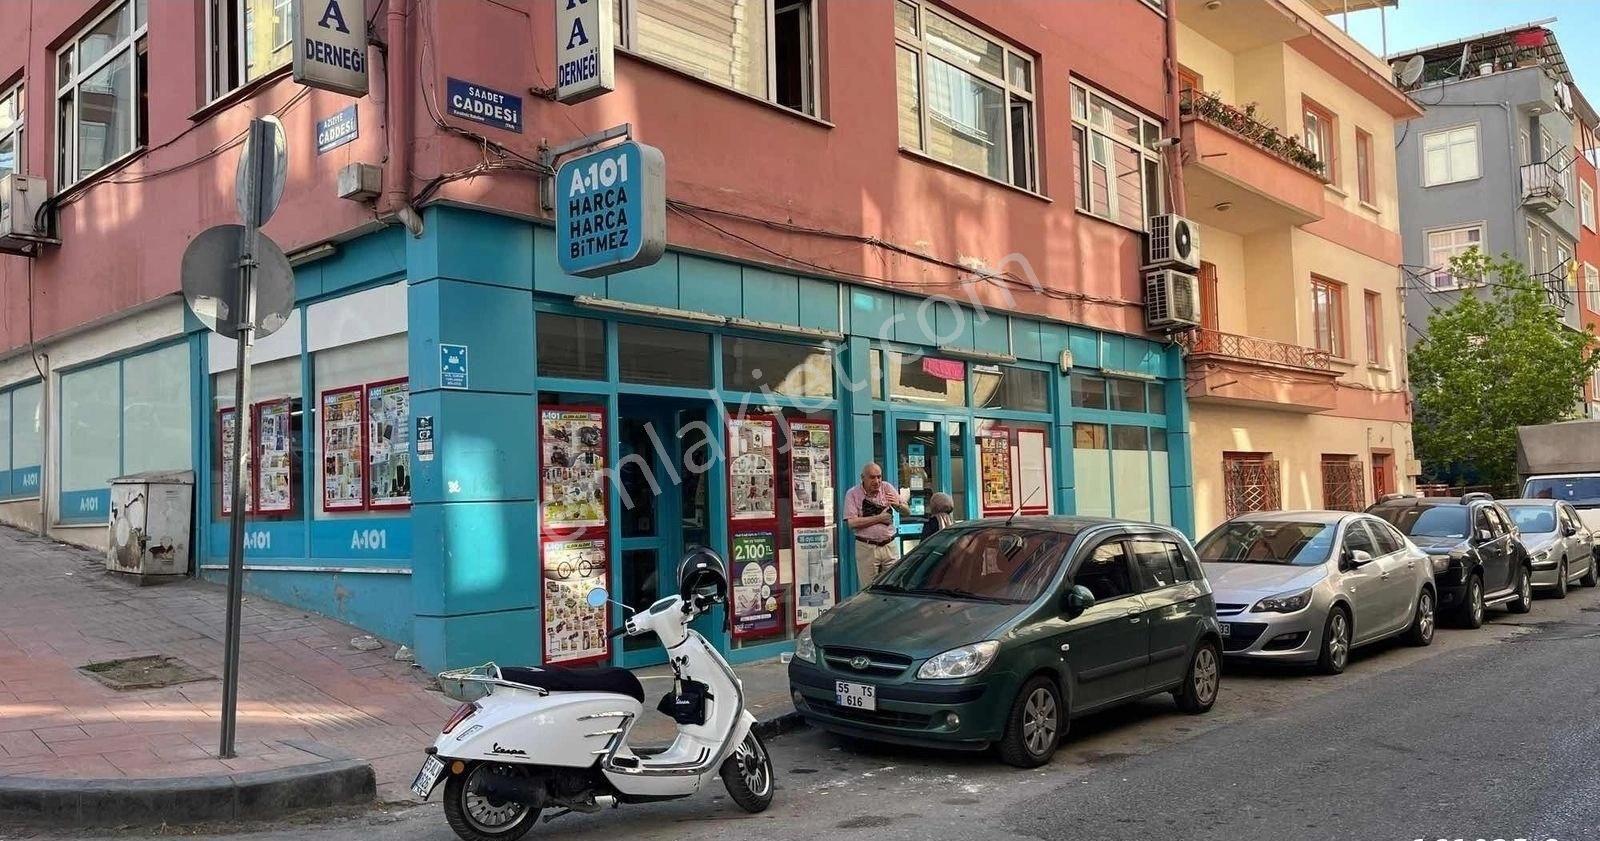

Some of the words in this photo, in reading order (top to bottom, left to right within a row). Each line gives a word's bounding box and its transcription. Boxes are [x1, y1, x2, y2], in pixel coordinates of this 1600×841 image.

[559, 47, 598, 88] DERNEĞİ
[468, 86, 504, 105] SAADET
[453, 94, 517, 124] CADDESİ
[318, 117, 355, 146] CADDESİ
[569, 186, 628, 218] HARCA
[570, 208, 628, 239] HARCA
[735, 544, 765, 560] 2.100
[838, 683, 849, 694] 55
[861, 686, 873, 697] TS
[847, 695, 863, 707] 616
[491, 742, 528, 755] Vespa
